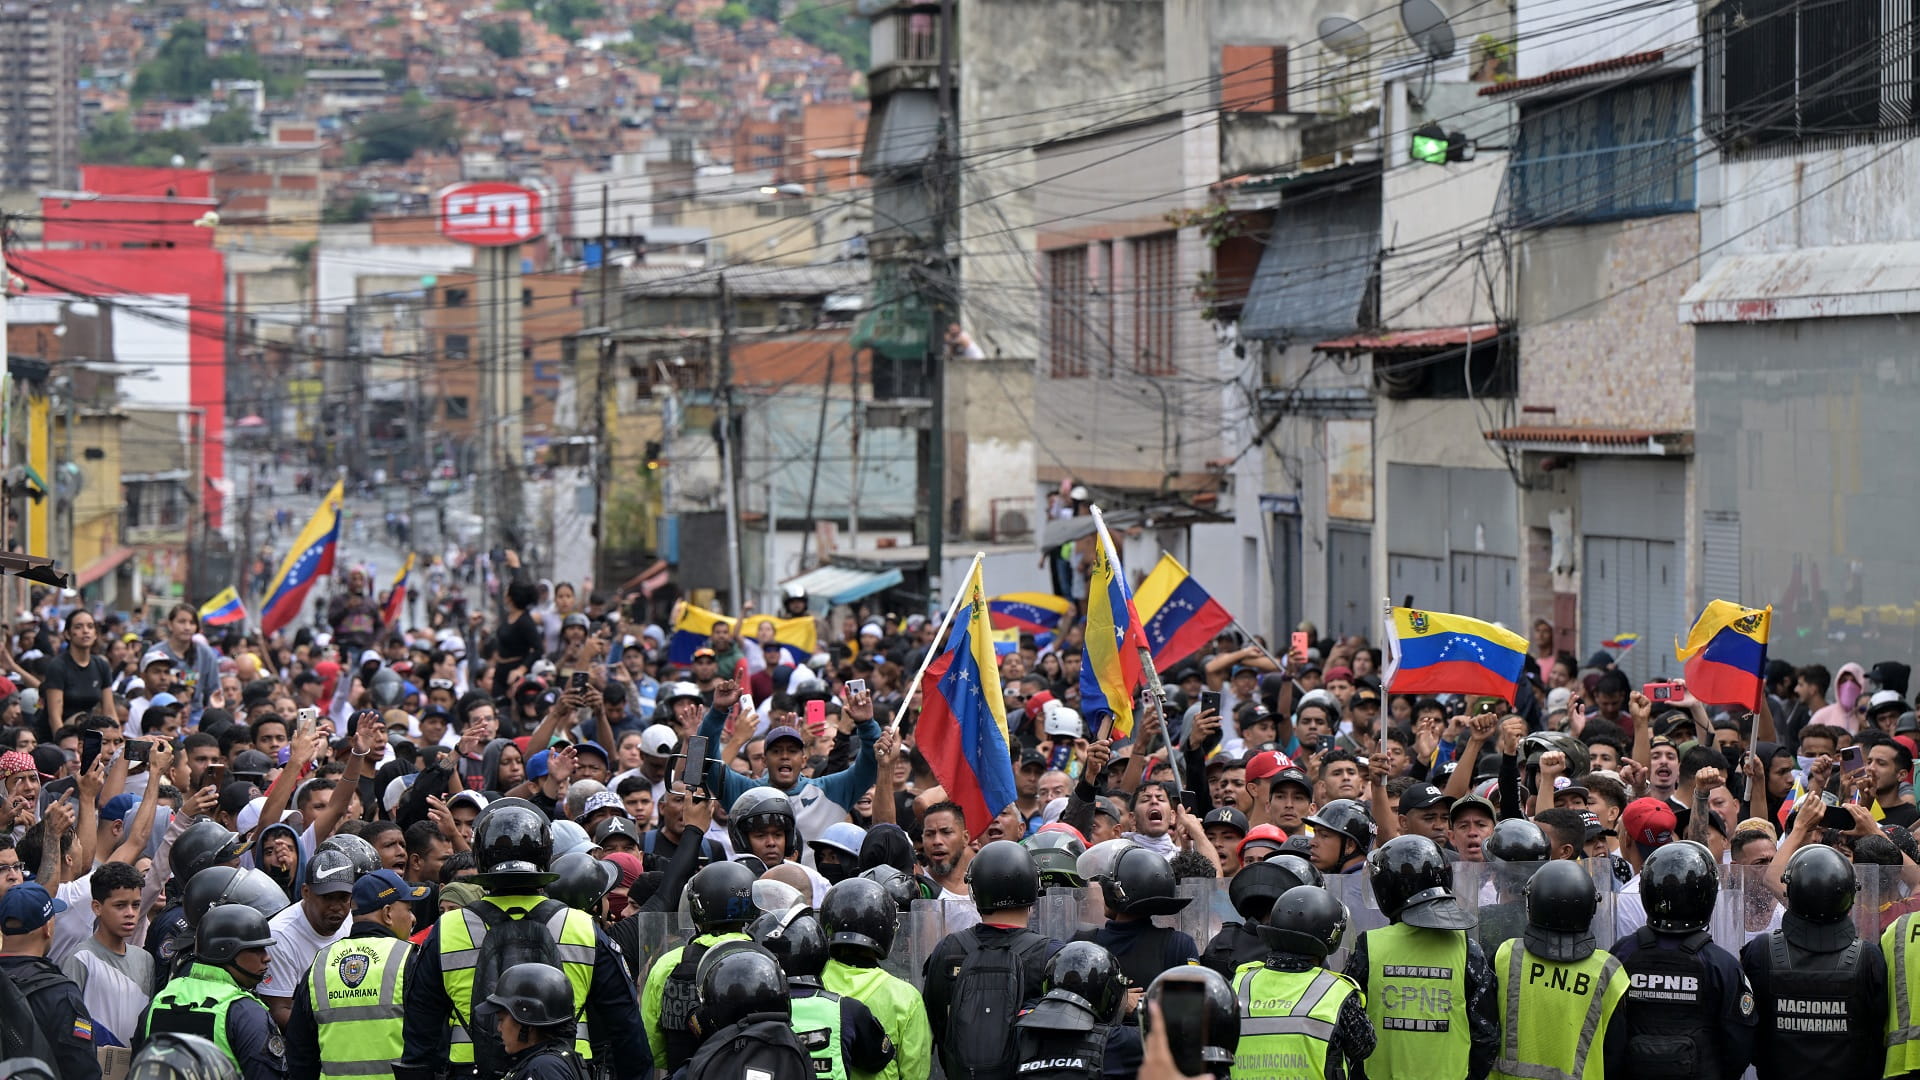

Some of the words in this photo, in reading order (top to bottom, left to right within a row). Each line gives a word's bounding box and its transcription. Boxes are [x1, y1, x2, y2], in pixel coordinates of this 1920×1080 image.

[1530, 962, 1590, 995] P.N.B
[1630, 973, 1698, 991] CPNB
[328, 989, 378, 999] BOLIVARIANA
[1381, 985, 1453, 1013] CPNB
[1253, 999, 1293, 1009] 01078
[1777, 999, 1848, 1014] NACIONAL
[1777, 1017, 1848, 1031] BOLIVARIANA
[1019, 1058, 1083, 1072] POLICIA
[1262, 1053, 1309, 1068] NACIONAL
